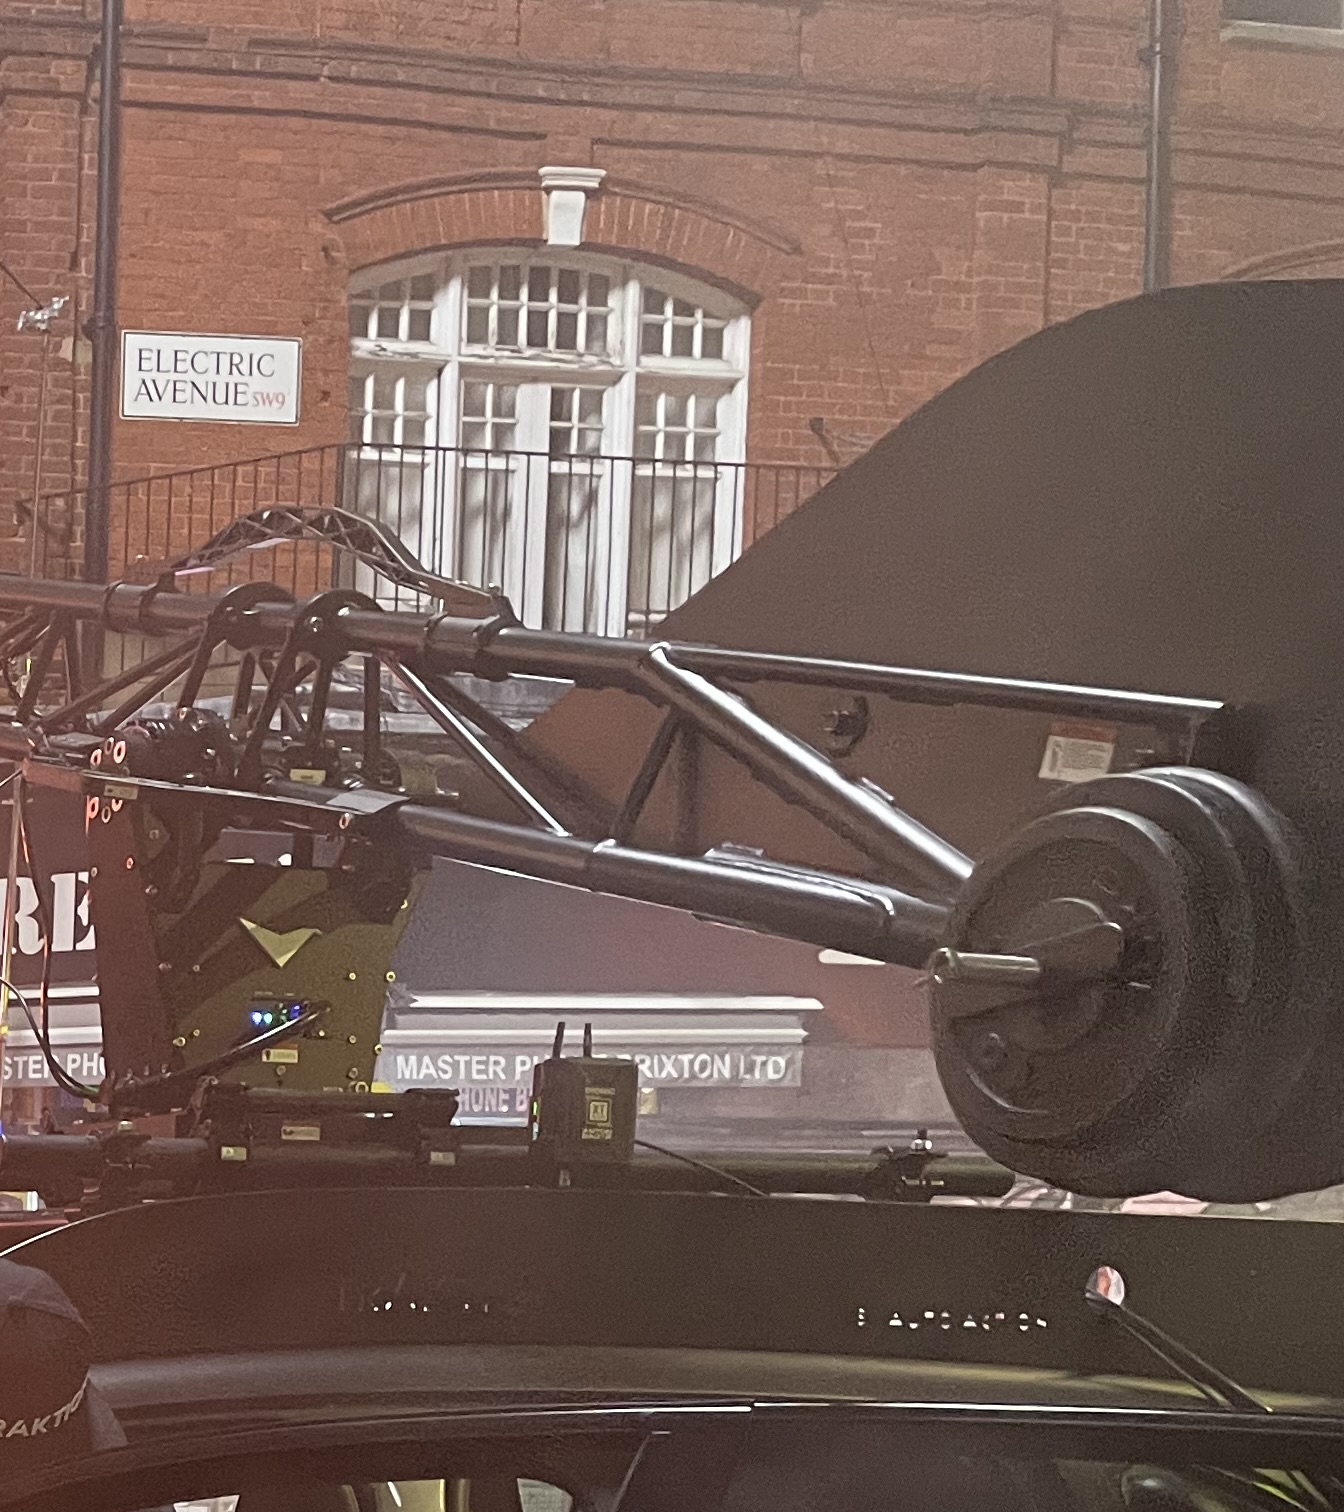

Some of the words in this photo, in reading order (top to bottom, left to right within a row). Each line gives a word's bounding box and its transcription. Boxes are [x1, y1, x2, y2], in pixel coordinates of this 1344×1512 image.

[137, 348, 276, 376] ELECTRIC
[133, 378, 249, 407] AVENUE
[252, 391, 286, 409] SW9
[396, 1055, 507, 1080] MASTER
[616, 1053, 731, 1079] RIXTON
[739, 1054, 787, 1080] LTD
